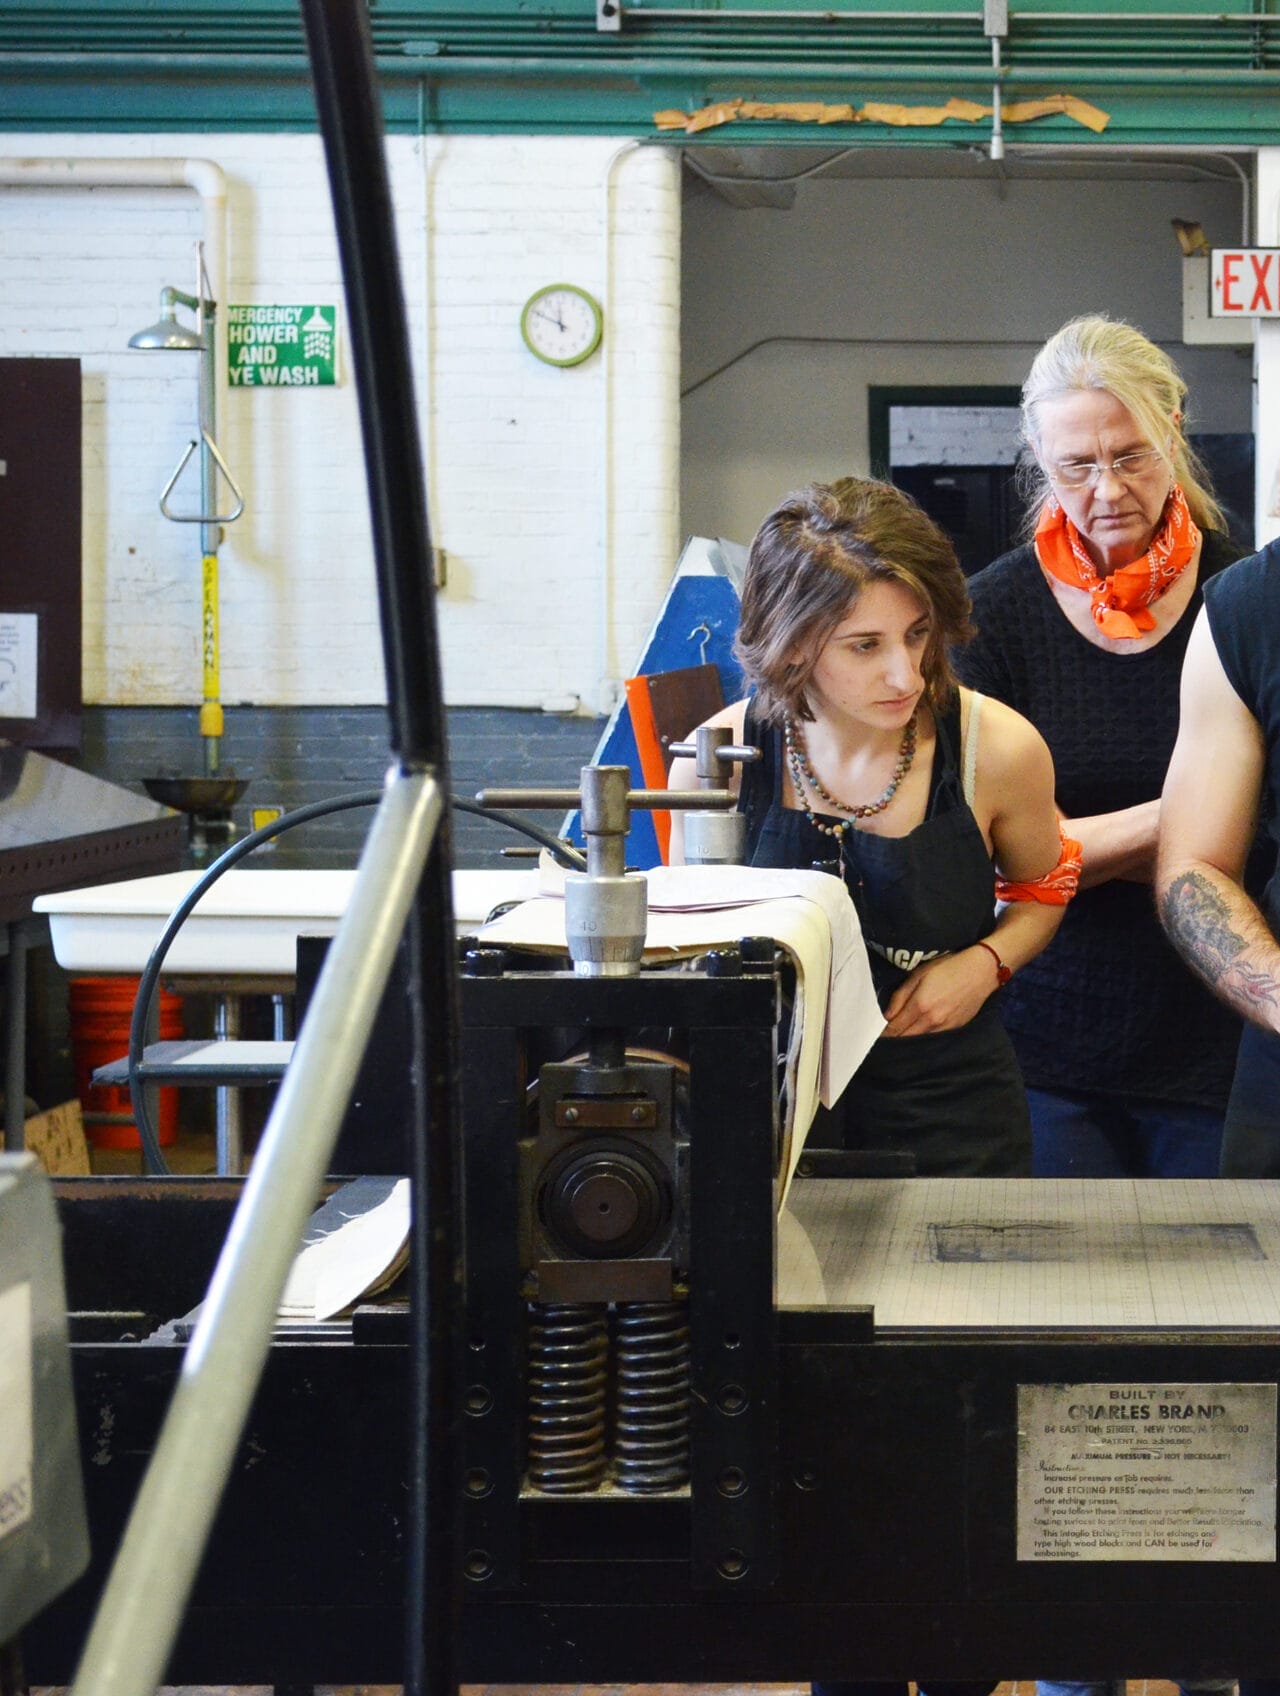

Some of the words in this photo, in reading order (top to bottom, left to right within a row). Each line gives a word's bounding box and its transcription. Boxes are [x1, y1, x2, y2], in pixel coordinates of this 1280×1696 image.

[228, 307, 303, 324] MERGENCY
[229, 324, 299, 344] HOWER
[238, 345, 277, 364] AND
[229, 365, 255, 385] YE
[259, 365, 319, 385] WASH
[204, 561, 215, 669] SPEAKMAN
[1109, 1390, 1156, 1400] BUILT
[1164, 1390, 1186, 1400] BY
[1068, 1404, 1151, 1420] CHARLES
[1159, 1404, 1226, 1420] BRAND
[1060, 1425, 1081, 1434] EAST
[1143, 1425, 1165, 1434] NEW
[1044, 1474, 1077, 1482] Increase
[1079, 1475, 1112, 1483] pressure
[1044, 1486, 1064, 1494] OUR
[1067, 1486, 1107, 1494] ETCHING
[1109, 1486, 1136, 1494] PRESS
[1138, 1486, 1170, 1495] requires
[1034, 1496, 1055, 1505] other
[1058, 1496, 1086, 1506] etching
[1052, 1508, 1067, 1516] you
[1095, 1507, 1117, 1515] these
[1043, 1529, 1058, 1537] This
[1092, 1529, 1120, 1538] Etching
[1166, 1529, 1199, 1538] etchings
[1054, 1540, 1072, 1549] high
[1074, 1540, 1097, 1548] wood
[1126, 1540, 1142, 1548] and
[1144, 1539, 1166, 1548] CAN
[1168, 1540, 1179, 1548] be
[1181, 1540, 1200, 1548] used
[1201, 1540, 1213, 1548] for
